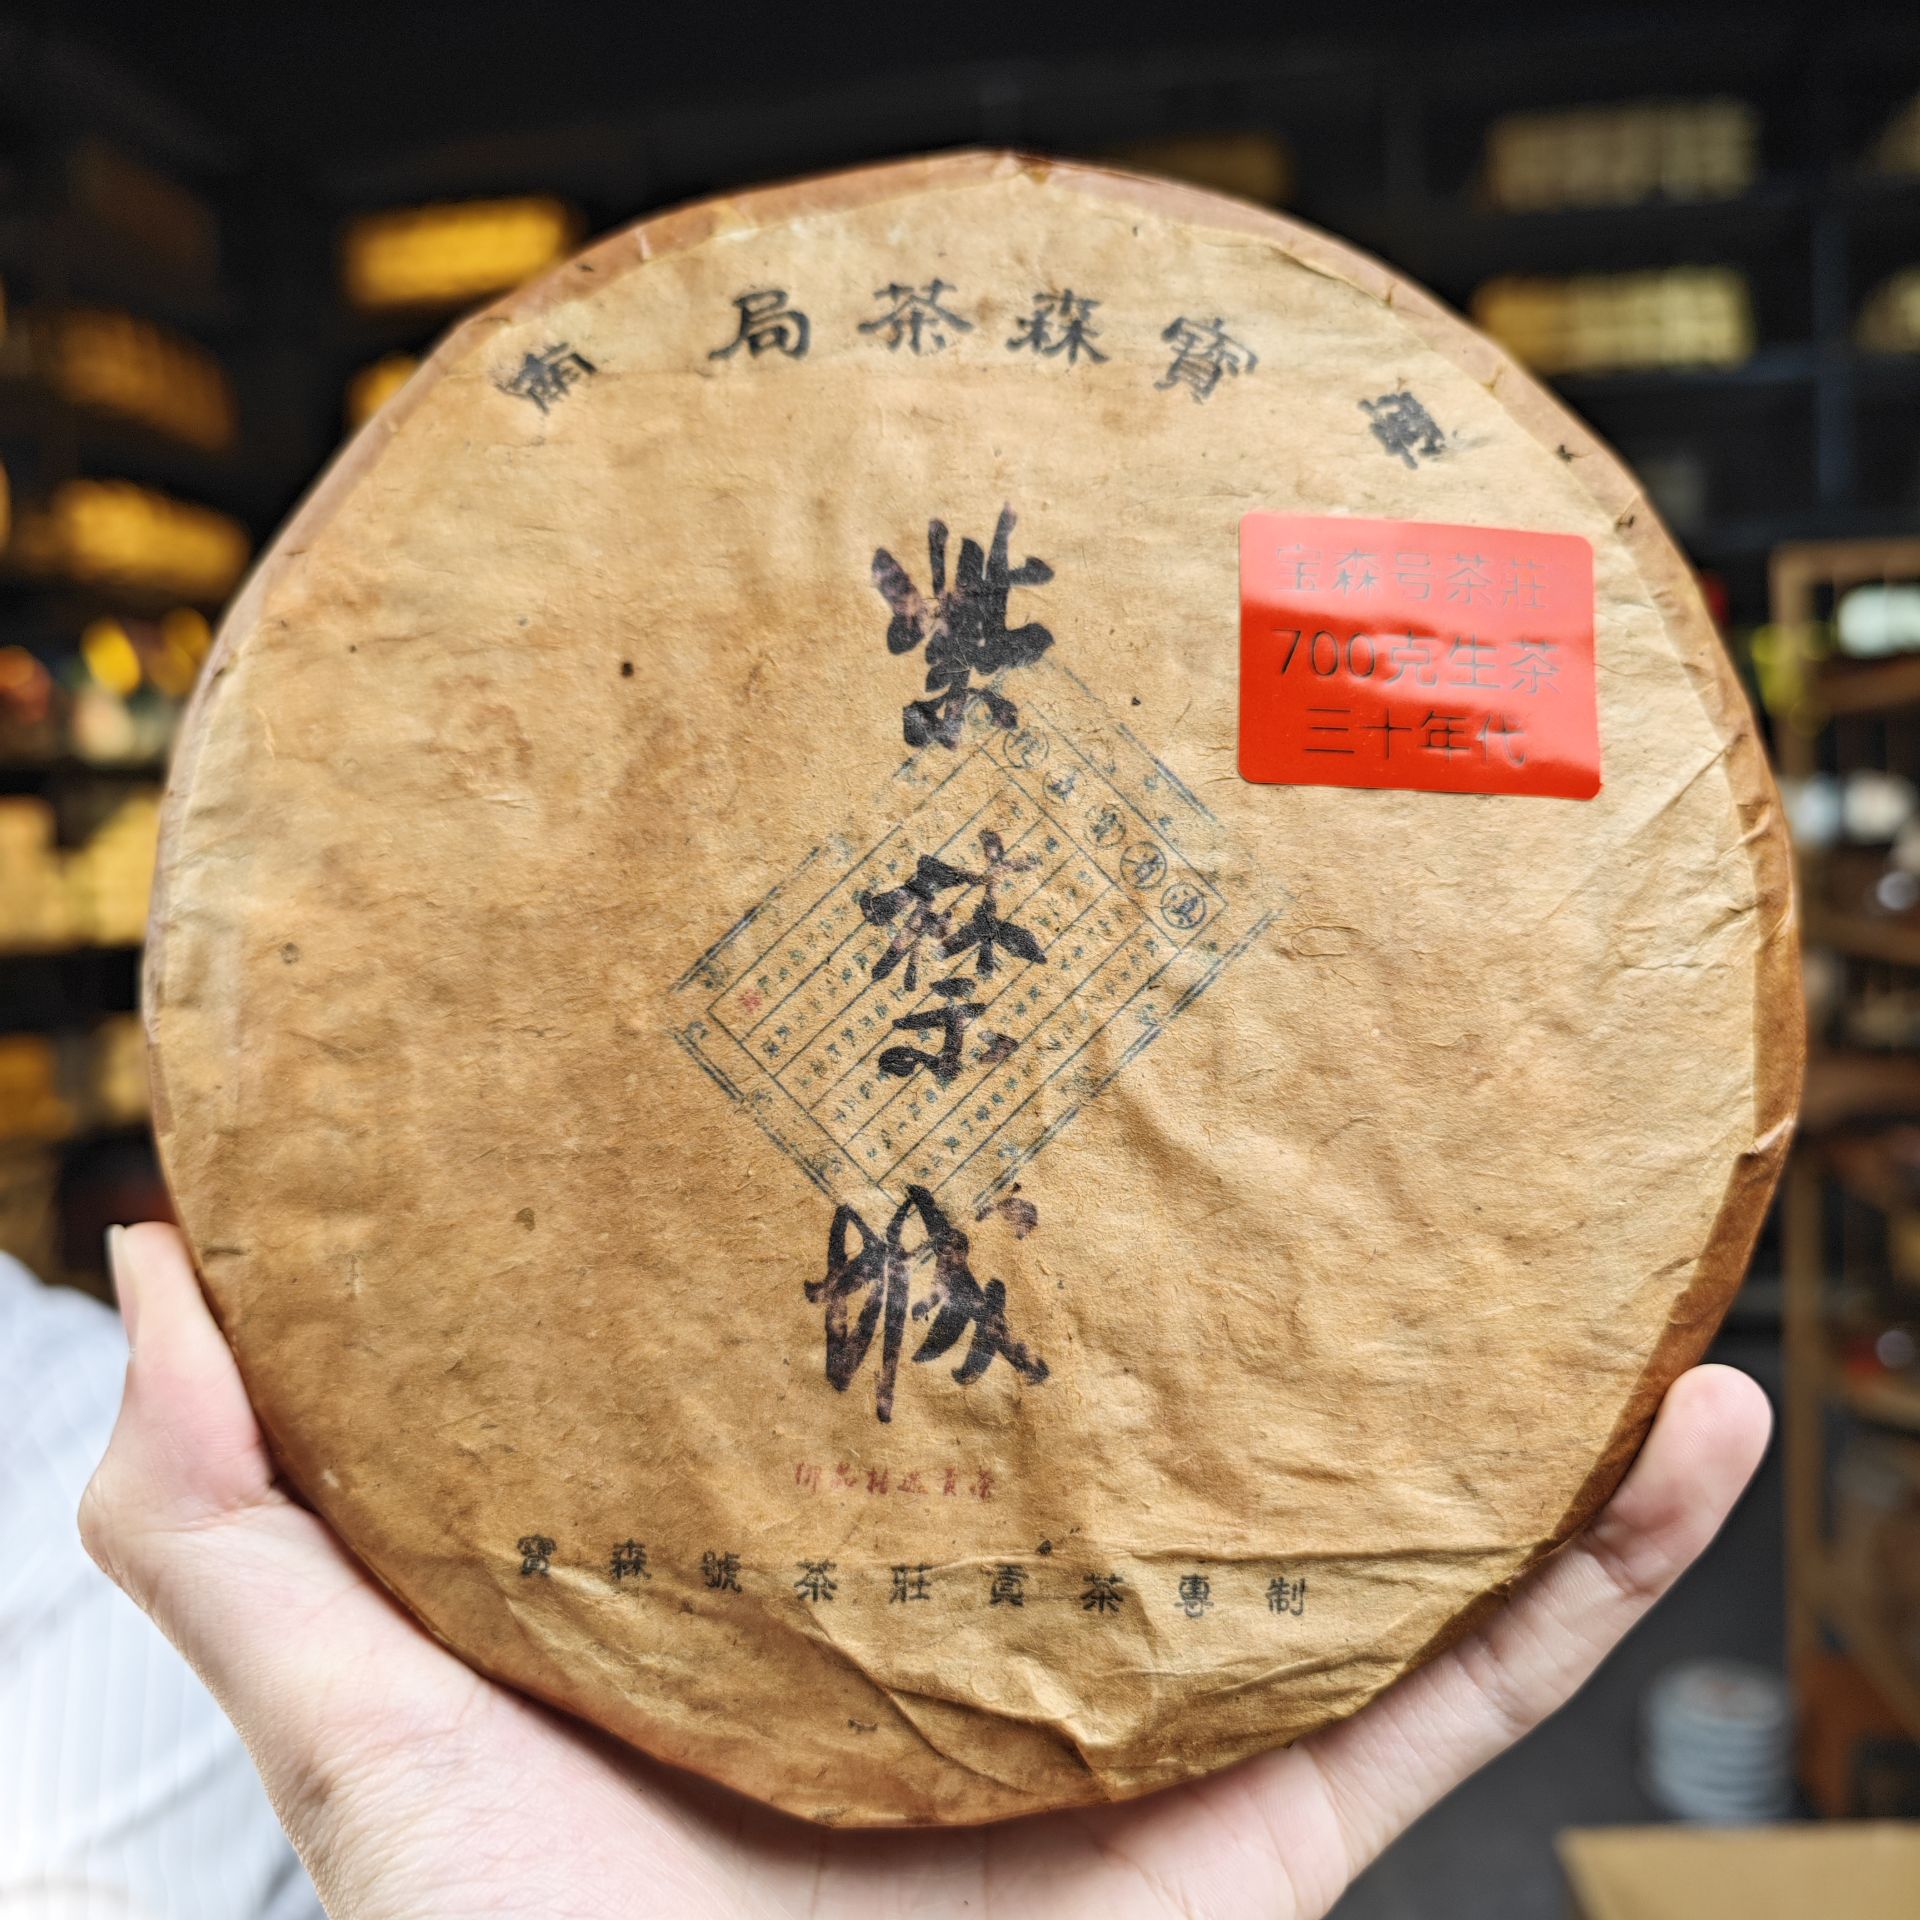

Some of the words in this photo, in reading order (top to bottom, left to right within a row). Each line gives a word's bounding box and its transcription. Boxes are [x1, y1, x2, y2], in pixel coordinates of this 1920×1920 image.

[1271, 628, 1562, 695] 700克生茶
[1303, 706, 1526, 767] 三十年代
